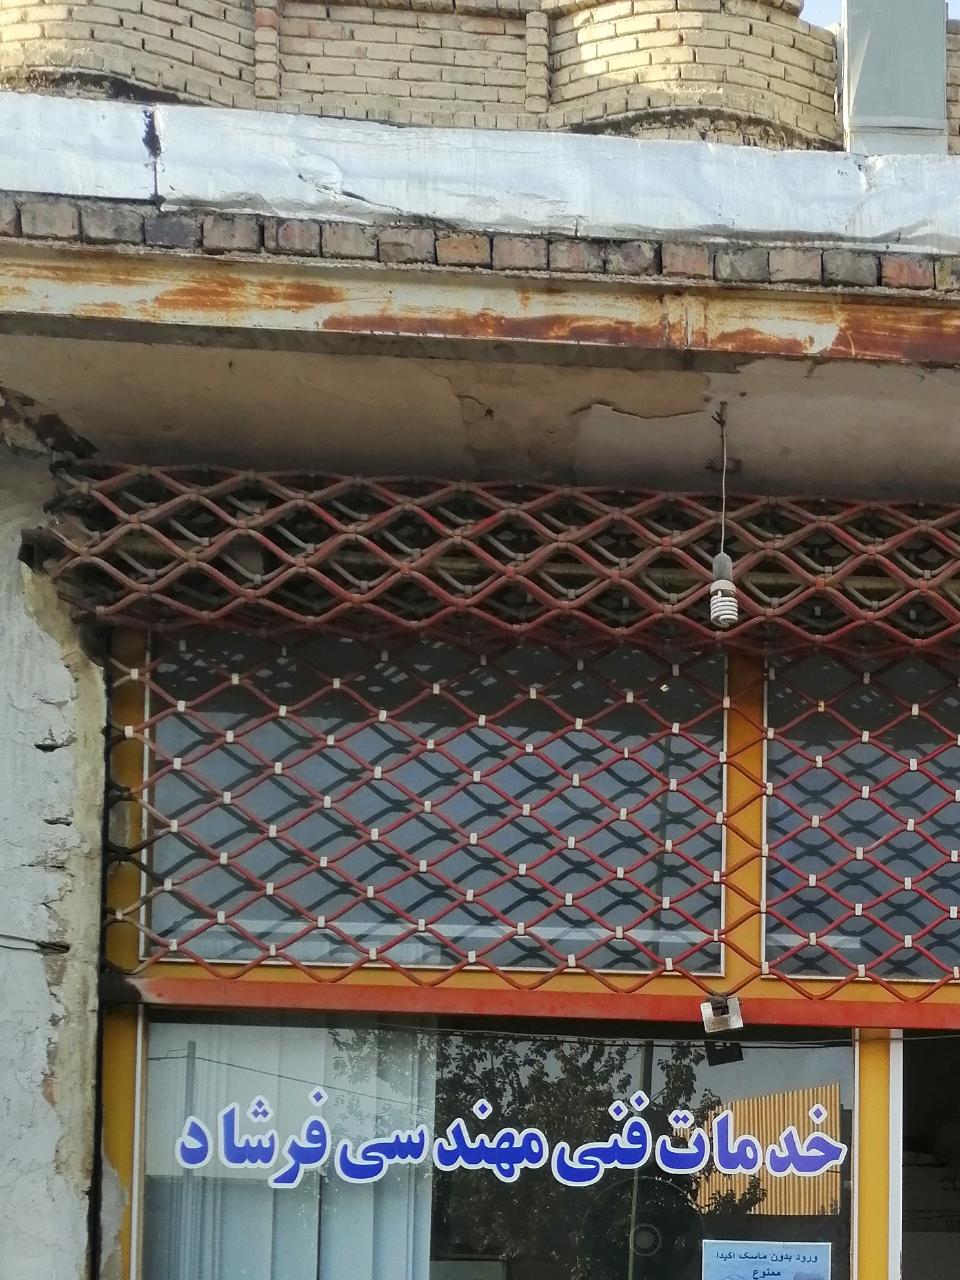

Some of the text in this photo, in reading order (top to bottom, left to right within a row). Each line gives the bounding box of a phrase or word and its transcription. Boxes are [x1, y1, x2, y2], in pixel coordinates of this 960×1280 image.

[177, 1087, 847, 1188] خدمات فنی مهندسی فرشاد
[739, 1251, 767, 1261] ماسک
[770, 1252, 792, 1262] بدون
[796, 1253, 818, 1263] ورود
[752, 1268, 781, 1280] ممنوع
